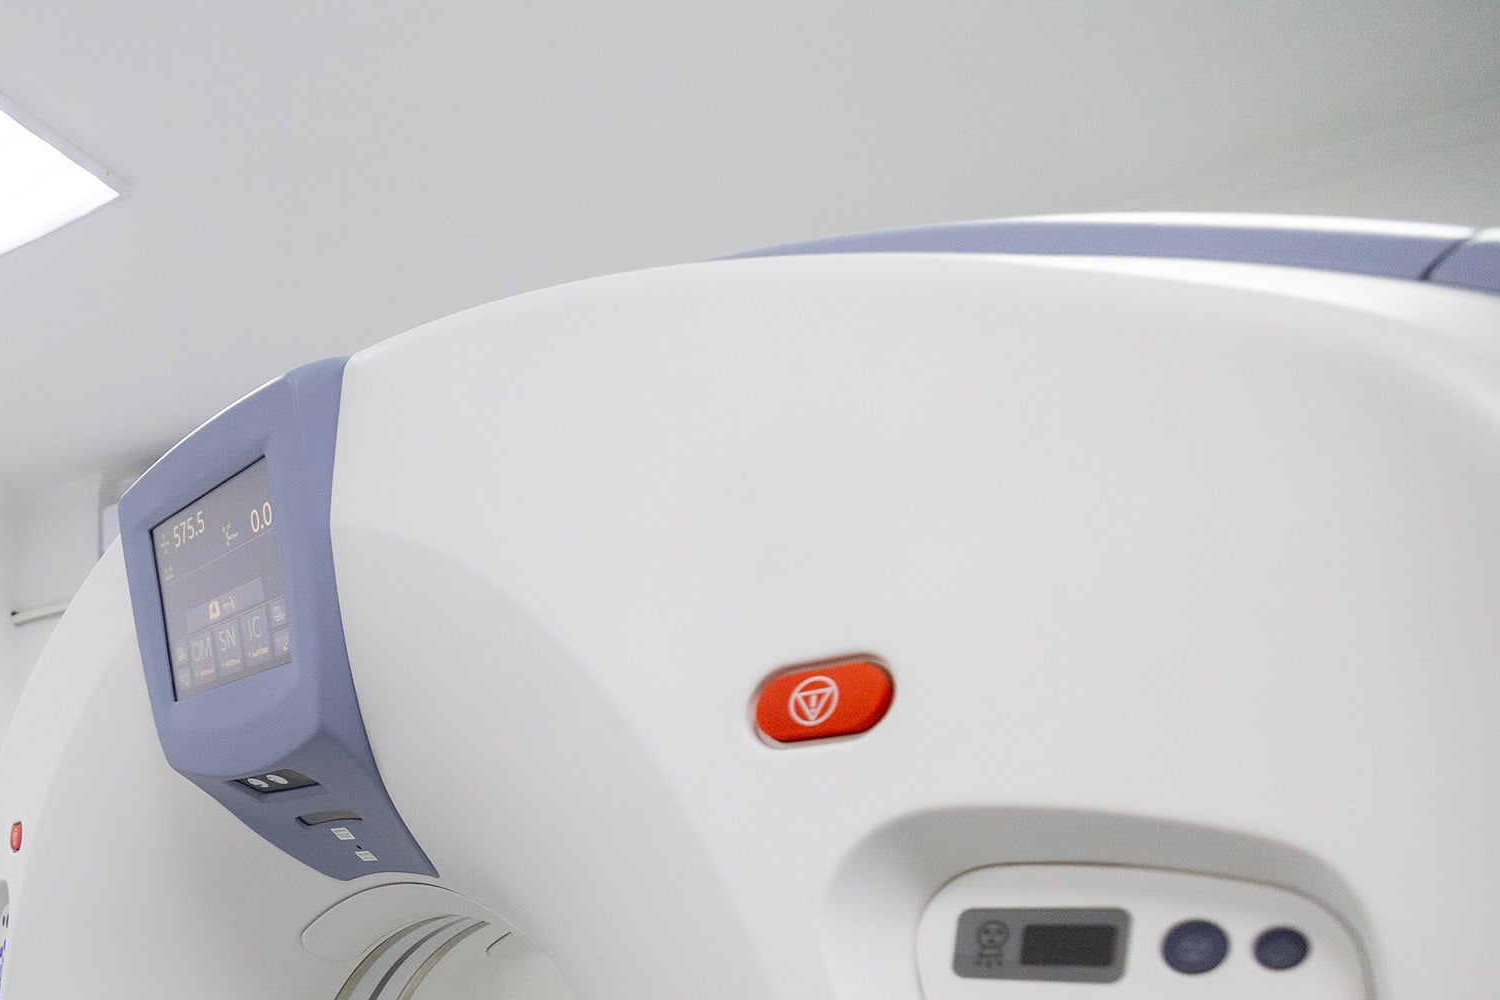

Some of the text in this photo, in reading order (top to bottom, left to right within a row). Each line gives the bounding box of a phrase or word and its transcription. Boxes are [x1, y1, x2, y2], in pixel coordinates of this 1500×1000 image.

[173, 511, 205, 548] 575.5
[250, 501, 273, 533] 0.0
[218, 625, 236, 652] SN
[248, 615, 262, 640] IC
